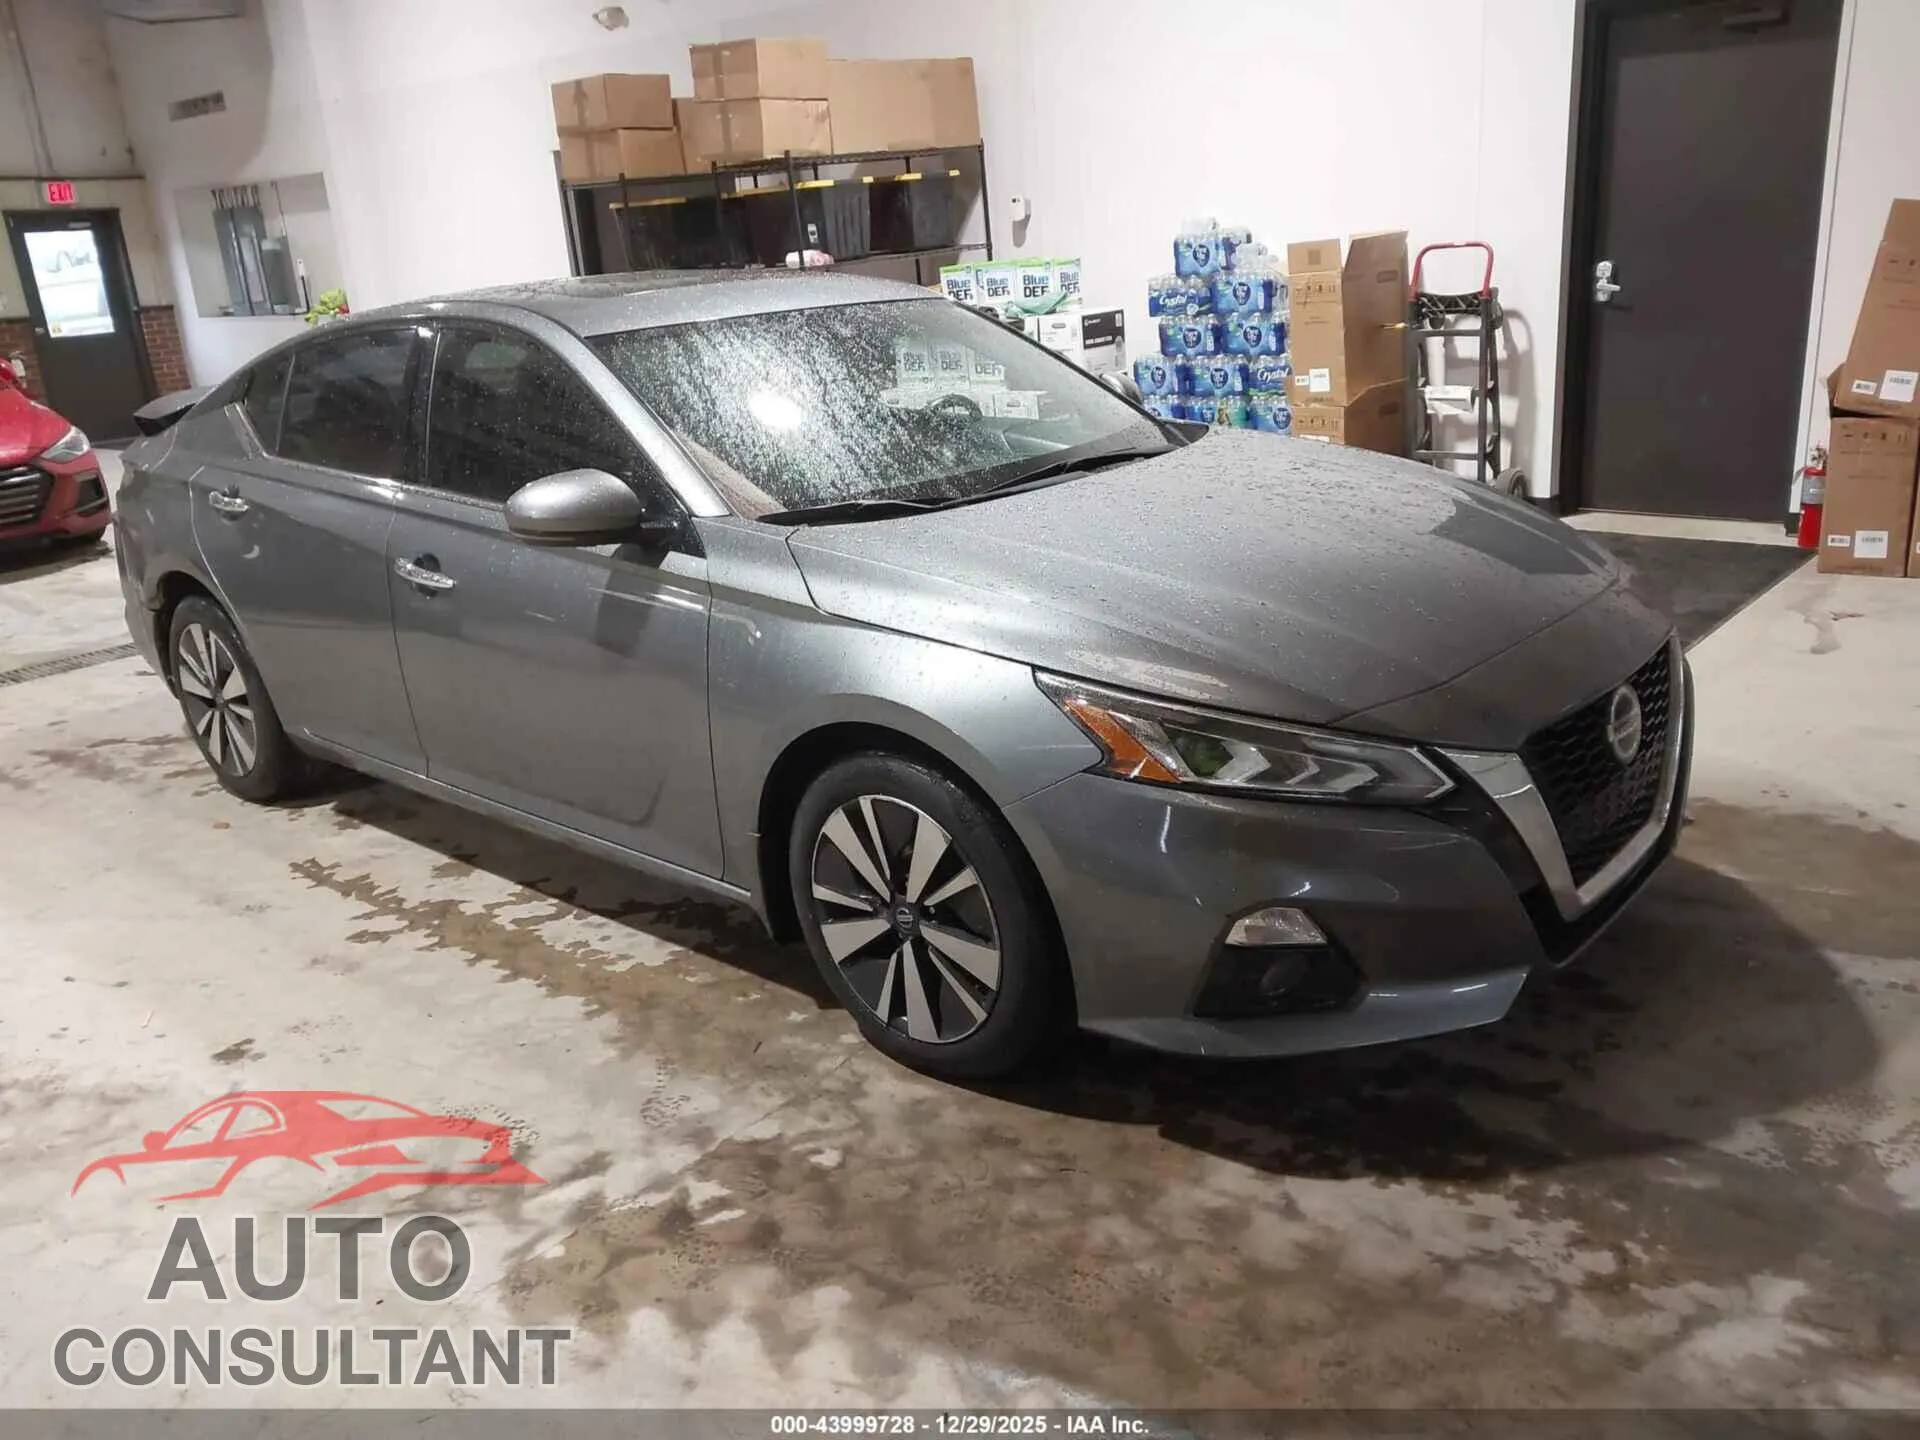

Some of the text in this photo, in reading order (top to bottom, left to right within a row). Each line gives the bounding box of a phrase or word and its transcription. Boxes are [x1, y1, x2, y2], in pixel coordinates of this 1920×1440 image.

[946, 279, 971, 289] Blue
[986, 277, 1009, 287] Blue
[1023, 274, 1049, 285] Blue
[1024, 286, 1049, 298] DEF
[1257, 367, 1289, 384] Crystal
